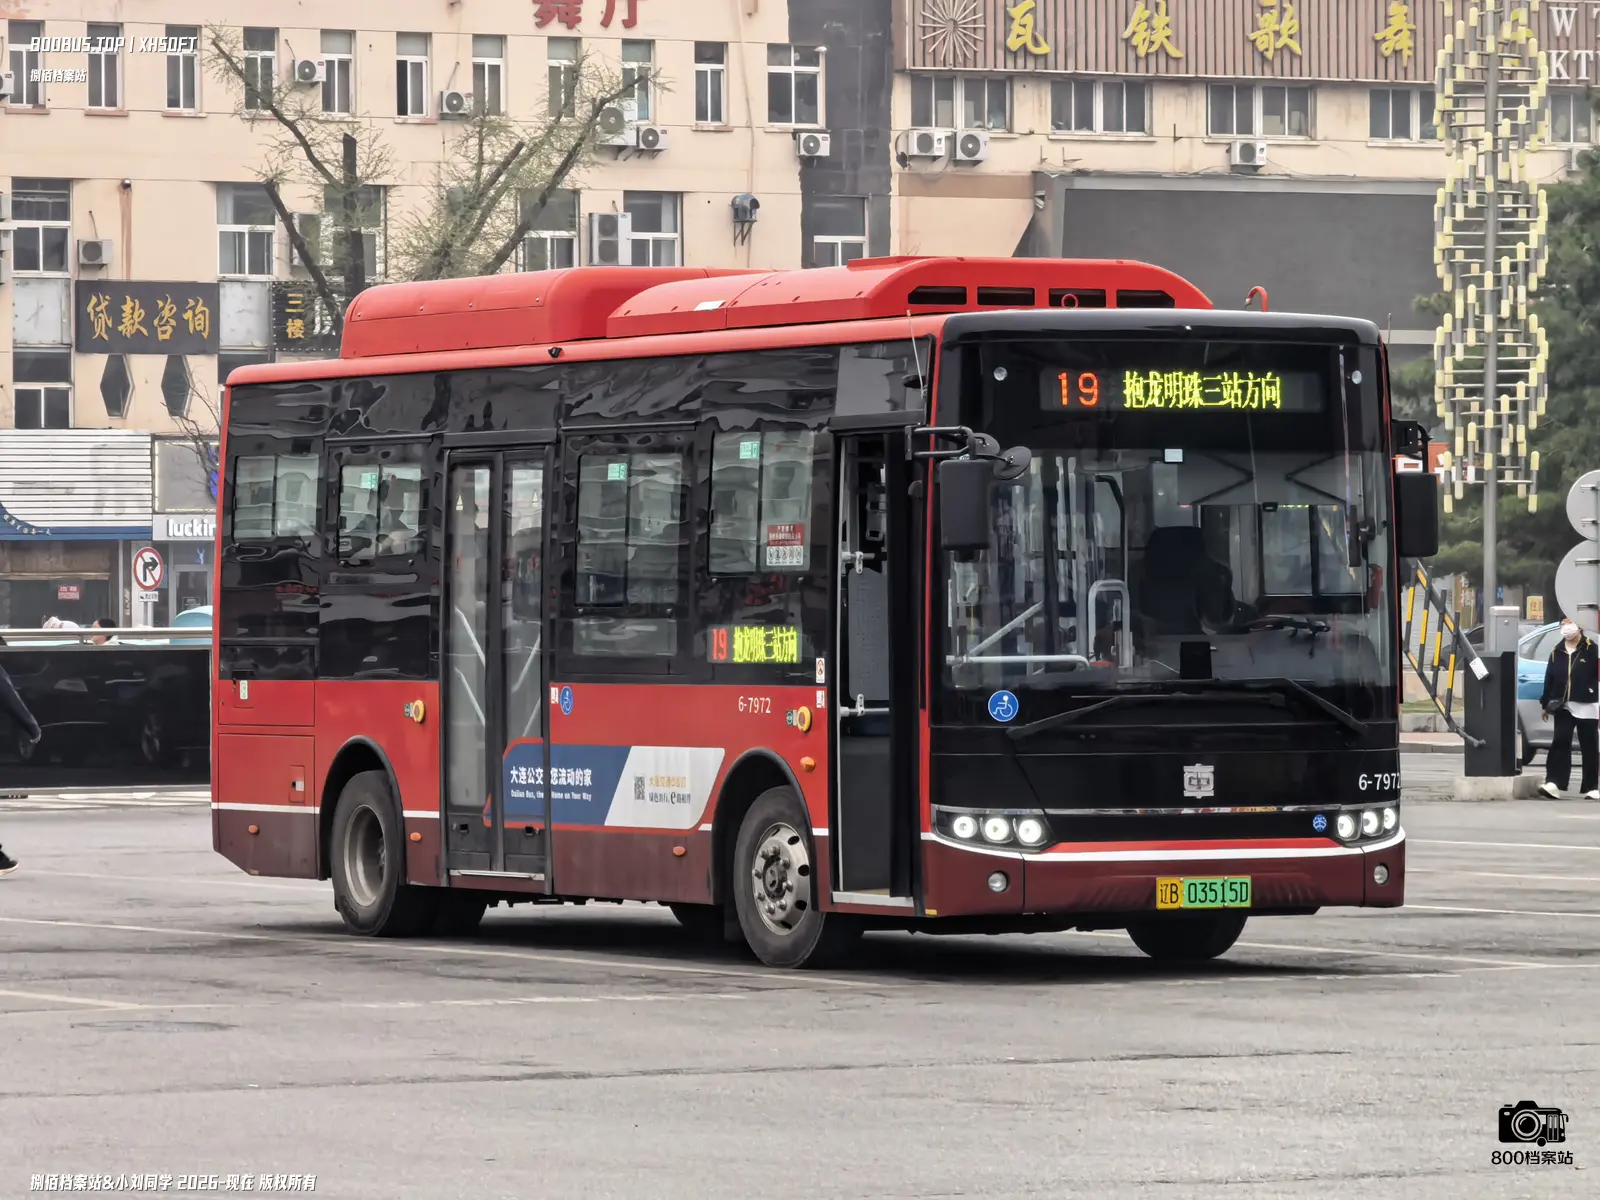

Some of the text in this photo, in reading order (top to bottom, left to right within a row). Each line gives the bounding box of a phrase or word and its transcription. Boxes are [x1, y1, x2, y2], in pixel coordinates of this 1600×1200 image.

[1547, 50, 1600, 80] KT
[86, 292, 211, 342] 贷款咨询
[285, 293, 305, 339] 三楼
[1058, 370, 1281, 409] 19 抱龙明珠三站方向
[712, 628, 729, 661] 19
[738, 695, 772, 714] 6-7972
[1159, 882, 1249, 904] 辽B 03515D
